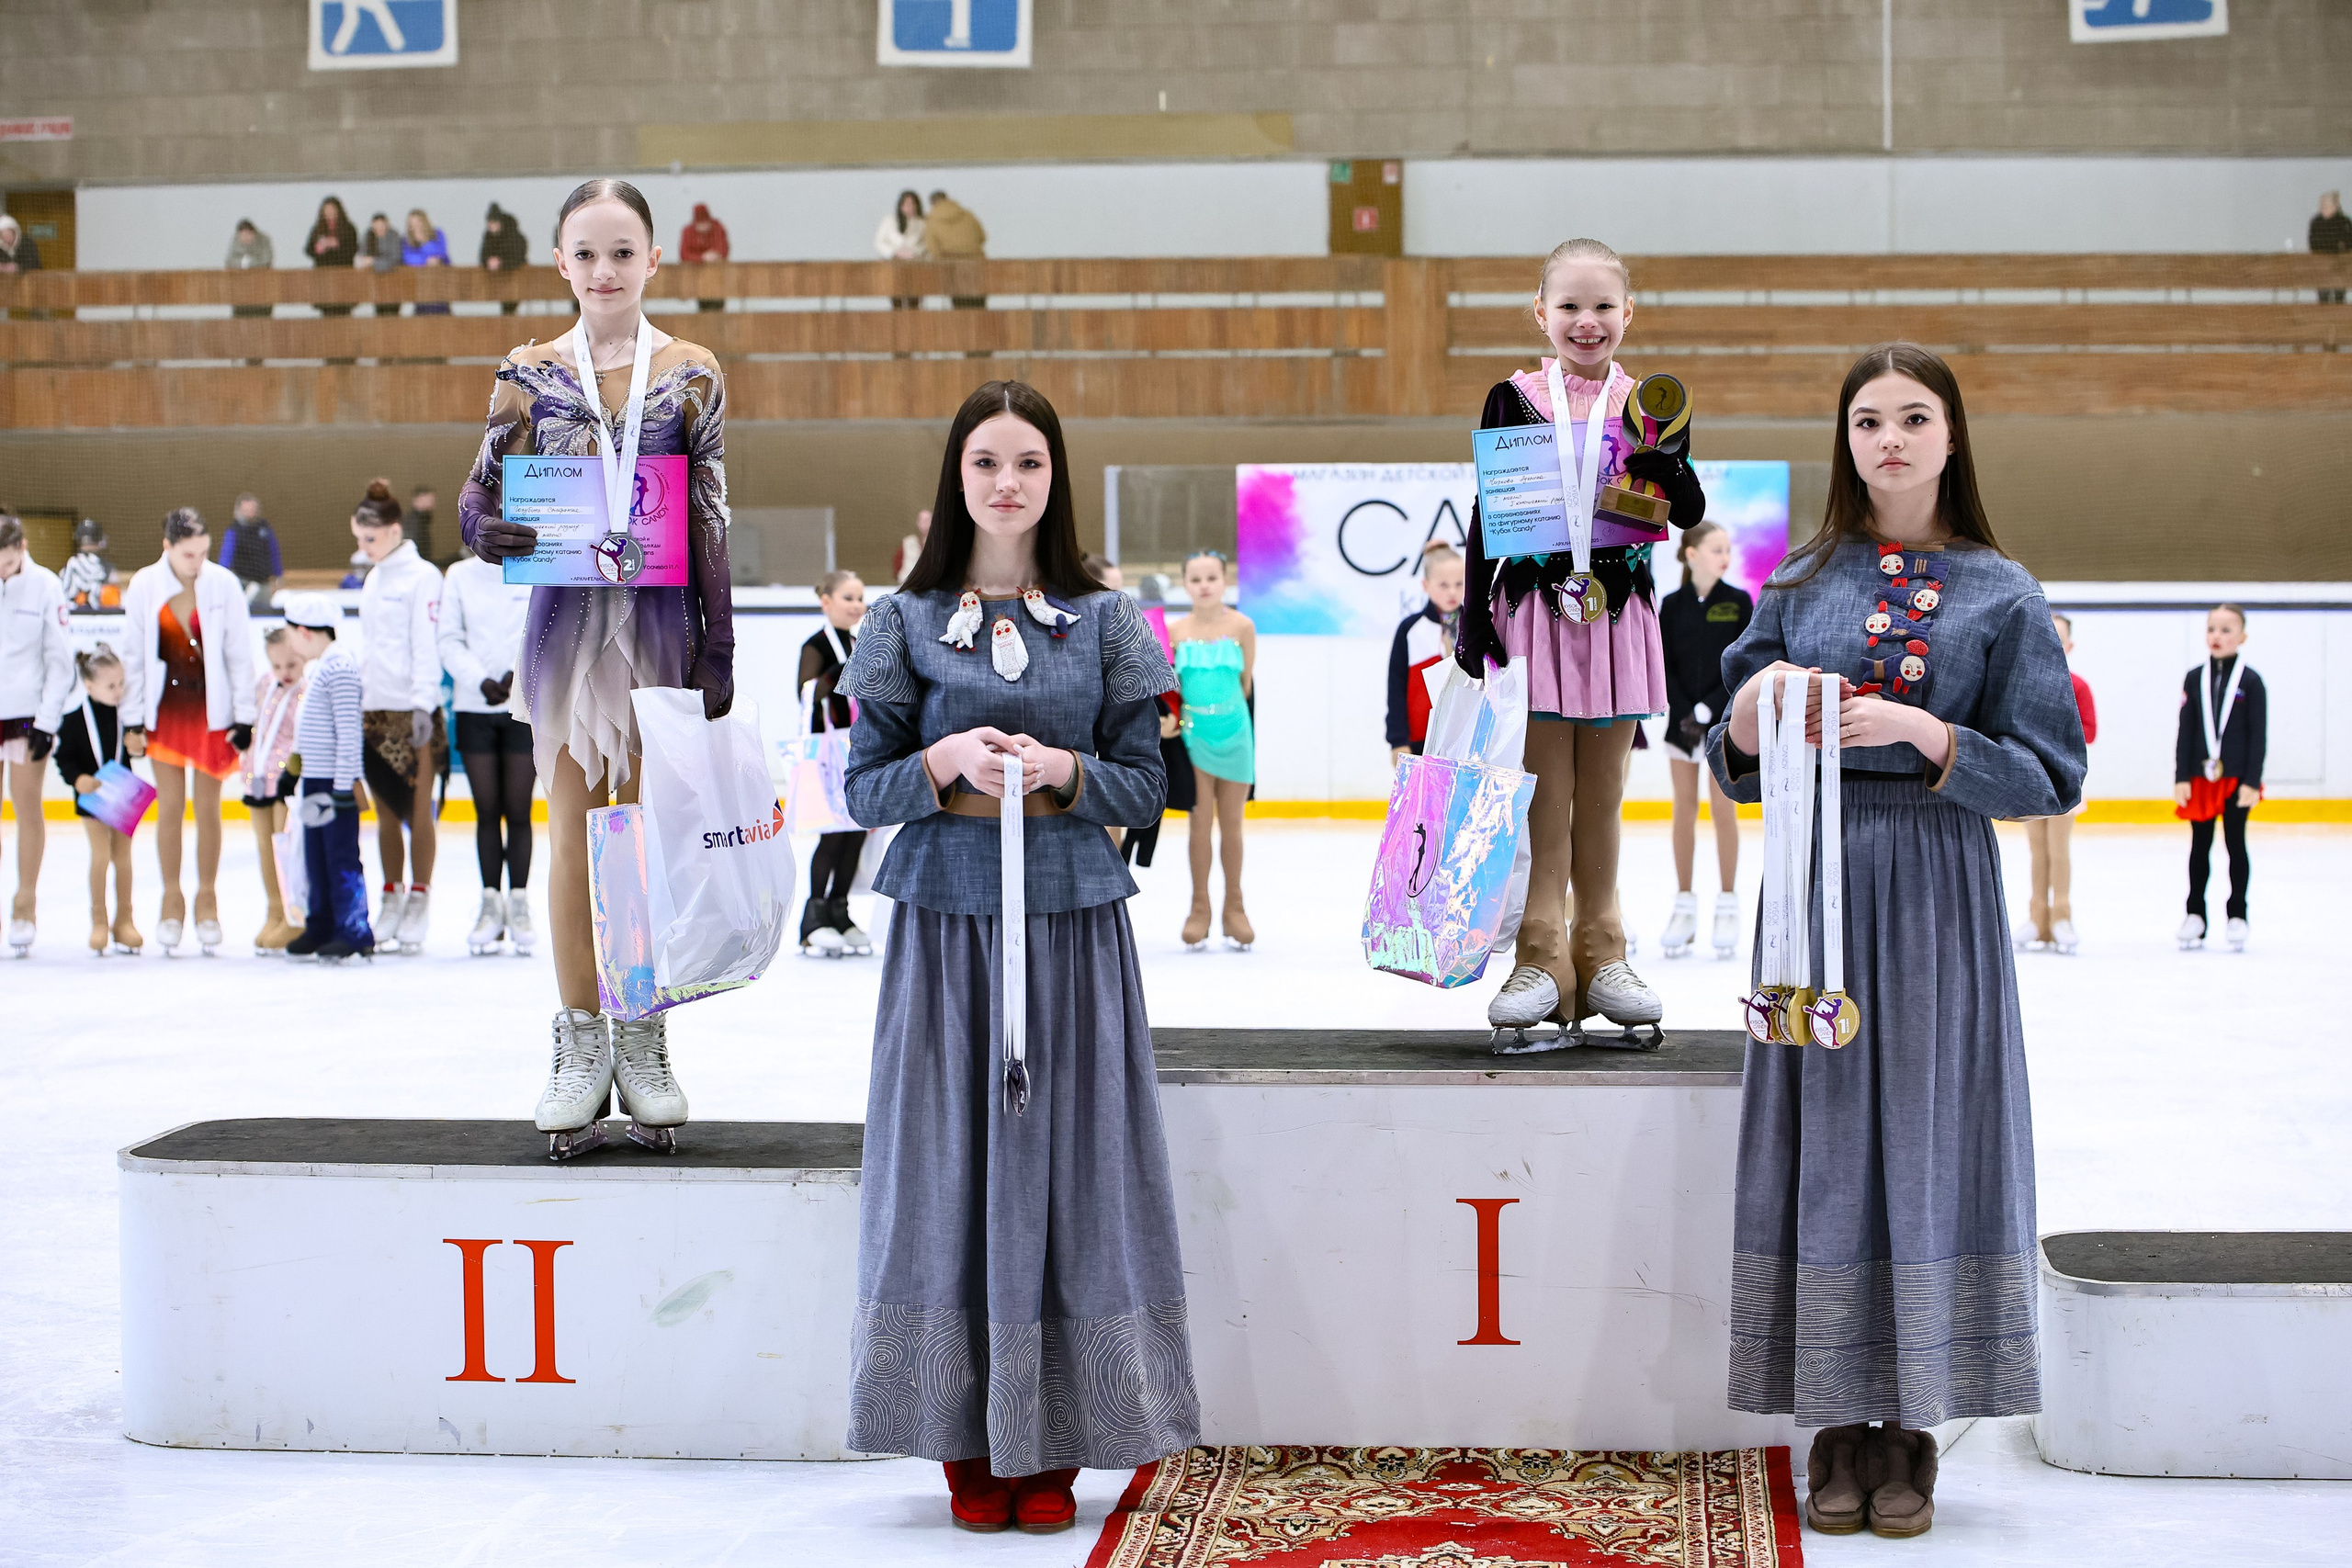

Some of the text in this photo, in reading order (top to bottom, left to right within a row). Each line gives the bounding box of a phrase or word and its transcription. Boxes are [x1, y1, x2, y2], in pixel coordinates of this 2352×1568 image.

[1482, 466, 1530, 477] Награждается
[509, 496, 556, 504] Награждается
[641, 503, 669, 525] CANDY
[1492, 509, 1542, 520] соревнованиях
[1498, 517, 1533, 527] фигурному
[1533, 514, 1562, 523] катанию
[623, 558, 632, 571] 2
[1586, 597, 1594, 612] 1
[703, 818, 771, 849] smartavia
[1838, 1018, 1846, 1034] 1
[1455, 1197, 1521, 1346] I
[442, 1238, 576, 1383] II
